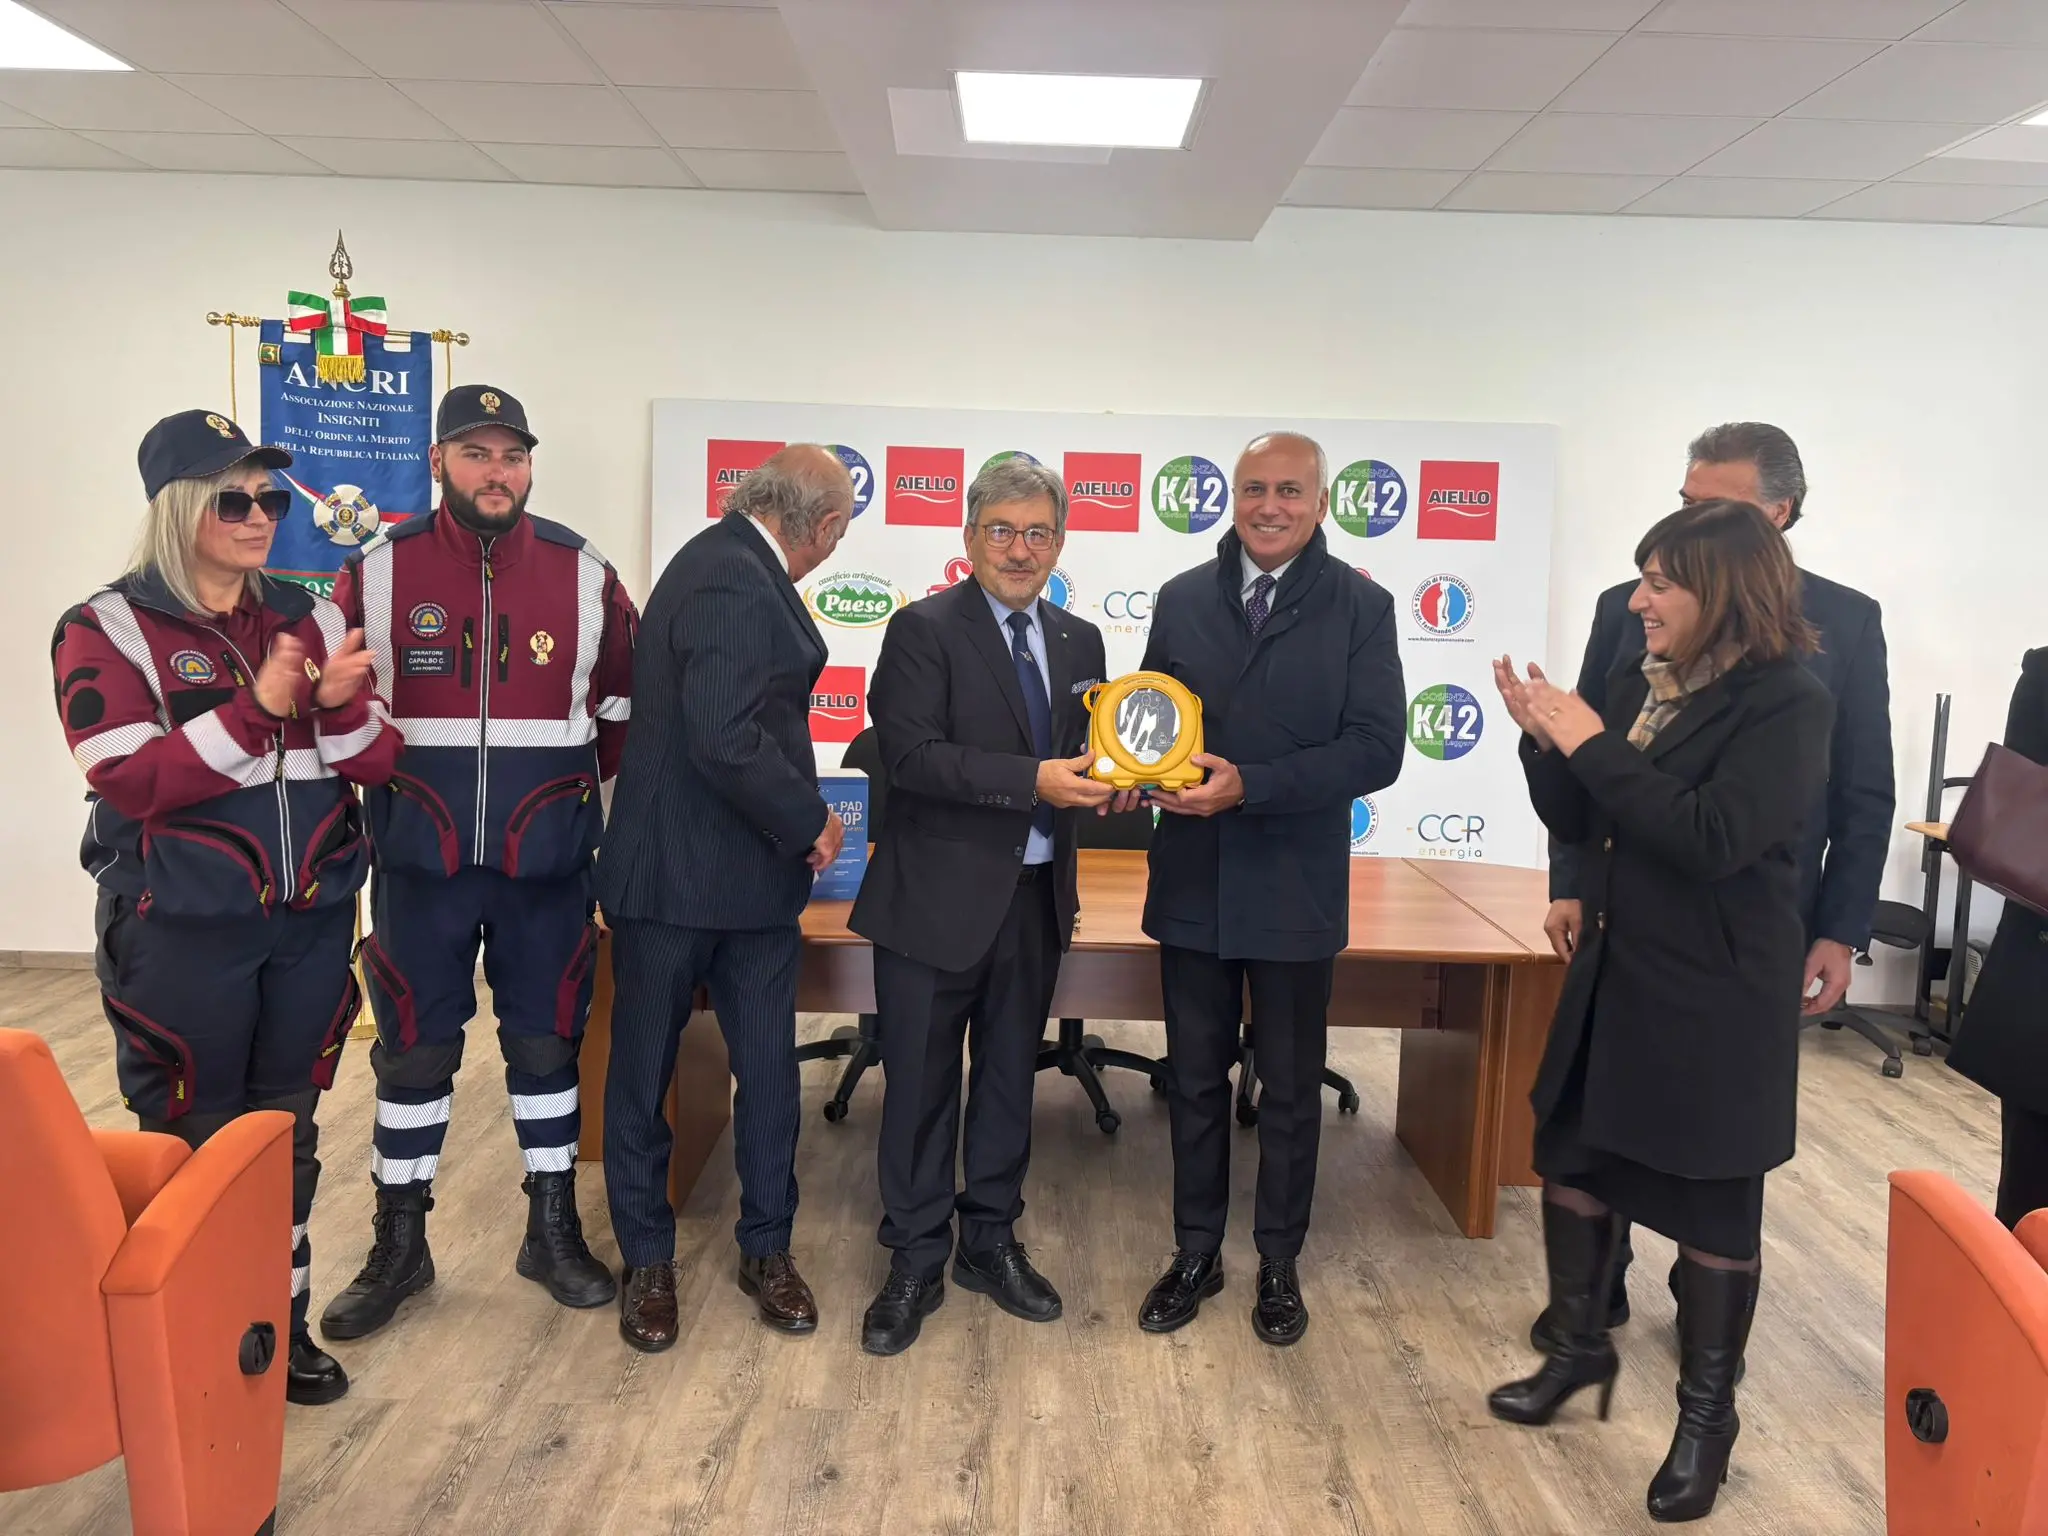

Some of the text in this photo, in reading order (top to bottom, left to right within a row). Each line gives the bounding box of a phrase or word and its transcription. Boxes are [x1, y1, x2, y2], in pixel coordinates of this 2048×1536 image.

[284, 362, 410, 395] ARI
[281, 392, 414, 412] ASSOCIAZIONE NAZIONALE
[318, 412, 380, 427] INSIGNITI
[284, 426, 314, 438] DELL'
[315, 431, 353, 442] ORDINE
[371, 435, 410, 445] MERITO
[275, 441, 420, 461] DELLA REPUBBLICA ITALIANA
[895, 475, 956, 492] AIELLO
[1071, 481, 1133, 497] AIELLO
[1158, 476, 1223, 512] K42
[1336, 480, 1401, 516] K42
[1427, 489, 1490, 505] AIELLO
[818, 570, 893, 588] caseificio artigianale
[1051, 568, 1073, 592] OTERAPIA
[1414, 580, 1431, 601] STUDIO
[1439, 576, 1472, 603] FISIOTERAPIA
[824, 594, 888, 613] Paese
[1105, 624, 1150, 636] energ
[1422, 621, 1452, 634] Ferdinando
[809, 694, 858, 708] IELLO
[1413, 704, 1478, 740] K42
[840, 801, 863, 812] PAD
[1418, 814, 1485, 843] CCR
[1419, 846, 1482, 859] energia
